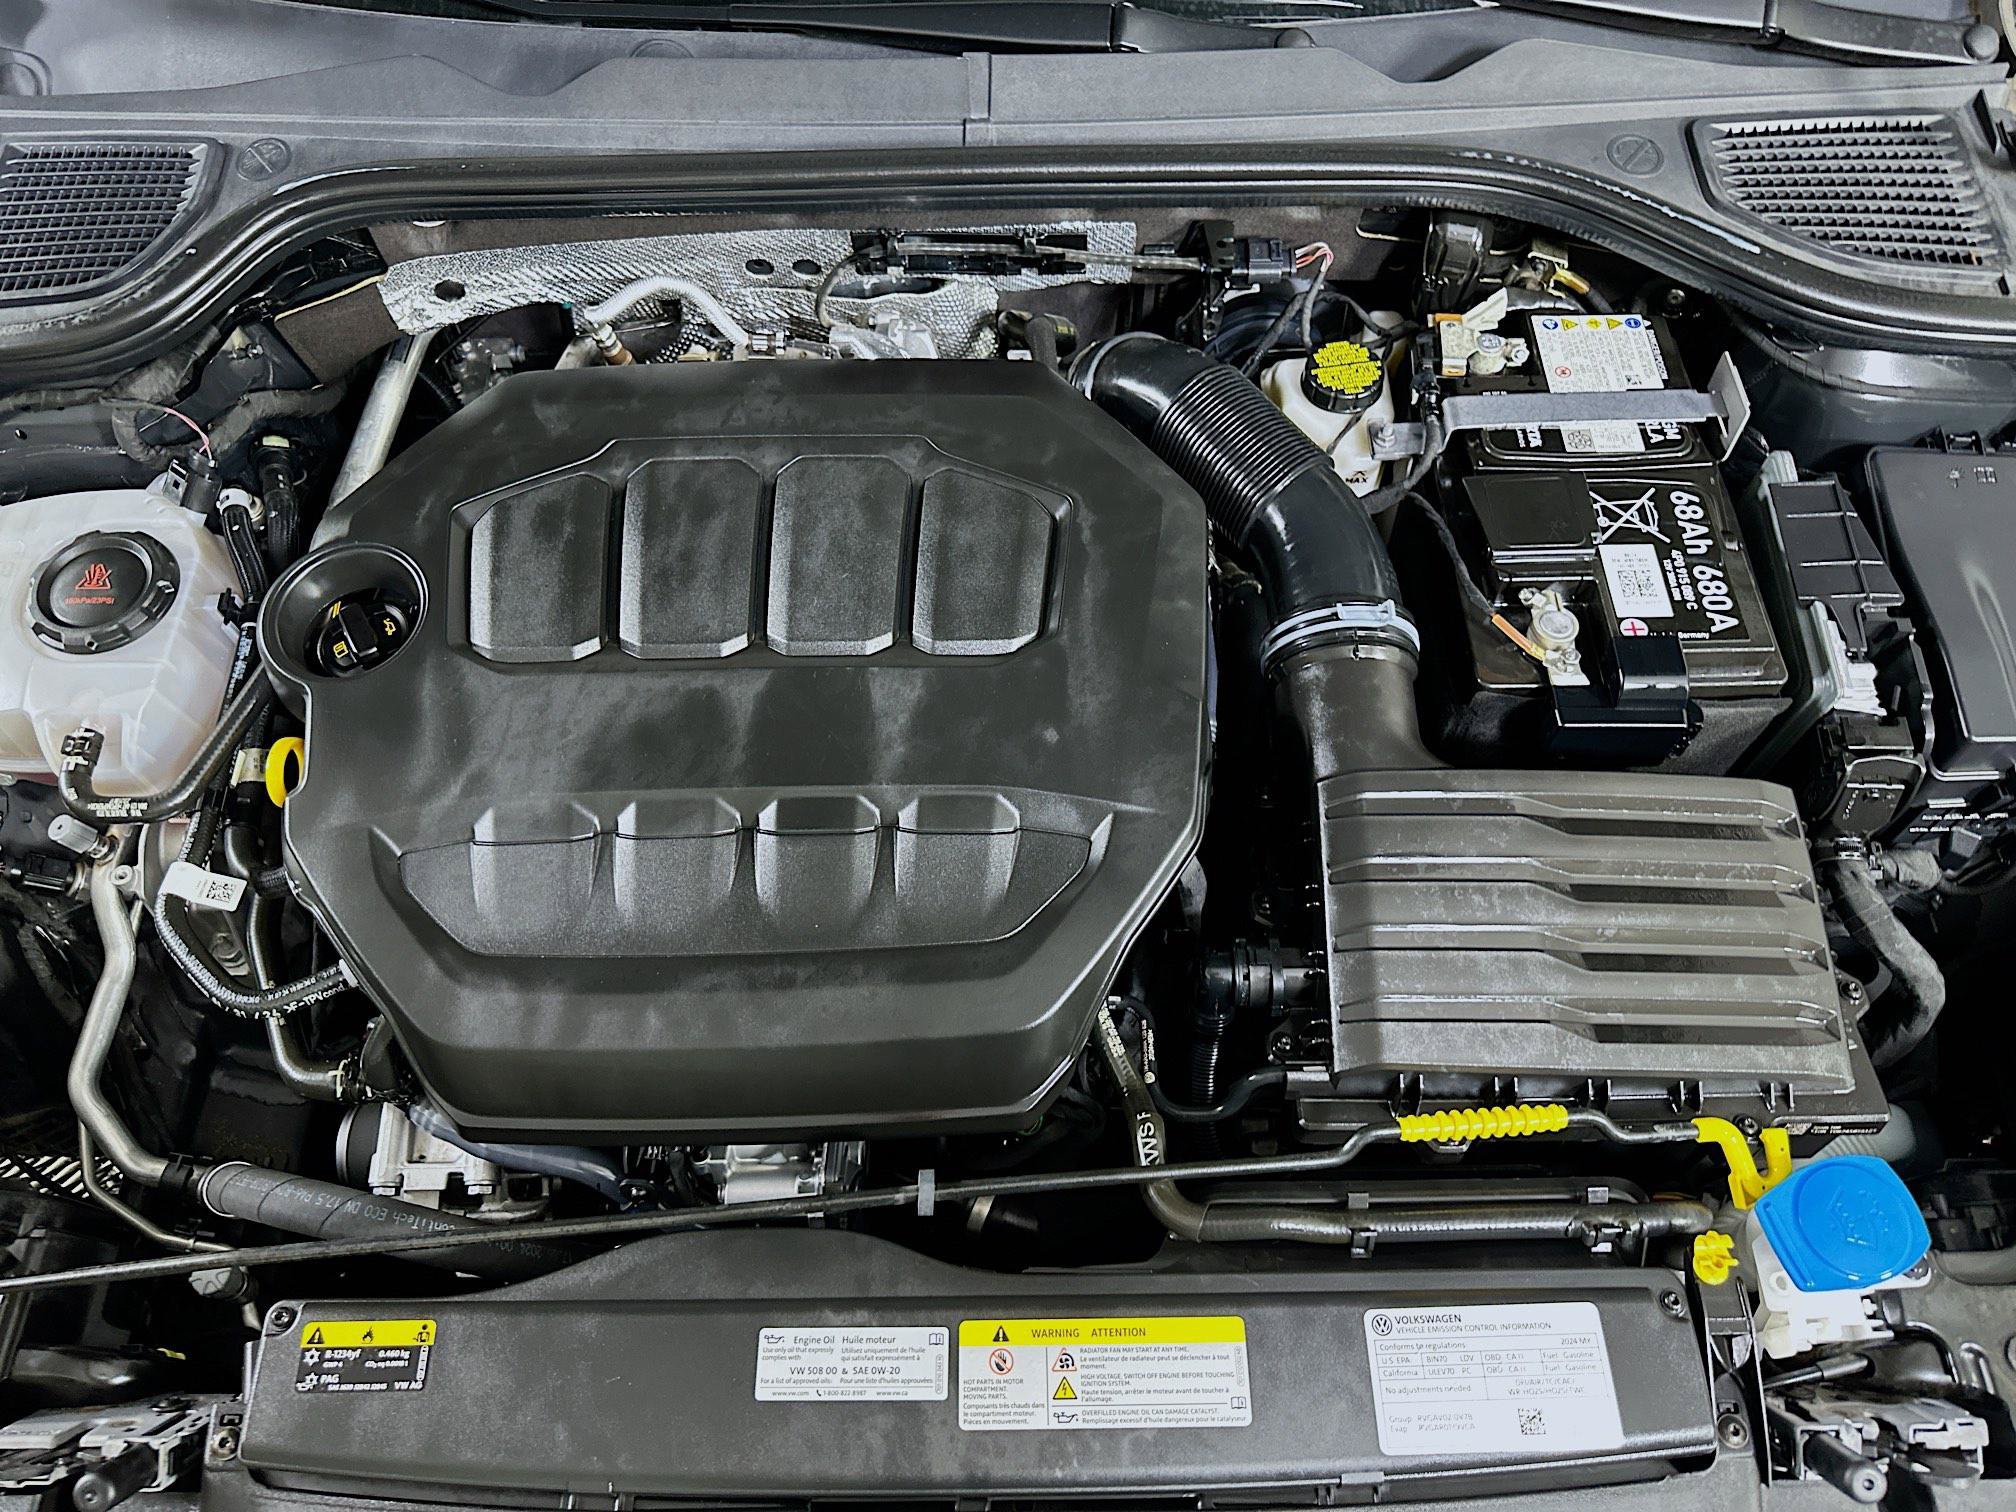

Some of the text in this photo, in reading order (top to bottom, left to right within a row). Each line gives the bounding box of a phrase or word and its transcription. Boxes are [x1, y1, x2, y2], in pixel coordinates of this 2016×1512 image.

[1670, 490, 1739, 633] 68Ah 680A
[1678, 632, 1709, 640] Germany
[364, 1205, 388, 1221] ECO
[1395, 1314, 1462, 1325] VOLKSWAGEN
[1465, 1324, 1498, 1332] CONTROL
[1501, 1323, 1551, 1331] INFORMATION
[1032, 1328, 1146, 1338] WARNING ATTENTION
[794, 1336, 835, 1345] Engine Oil
[842, 1336, 896, 1344] Huile moteur
[1426, 1342, 1466, 1351] regulations
[325, 1349, 362, 1360] R-1234yf
[1397, 1356, 1411, 1364] EPA
[790, 1367, 900, 1375] VW 508 00 & SAE 0W-20
[320, 1375, 340, 1384] PAG
[394, 1381, 423, 1390] VW AG
[1398, 1386, 1442, 1395] adjustments
